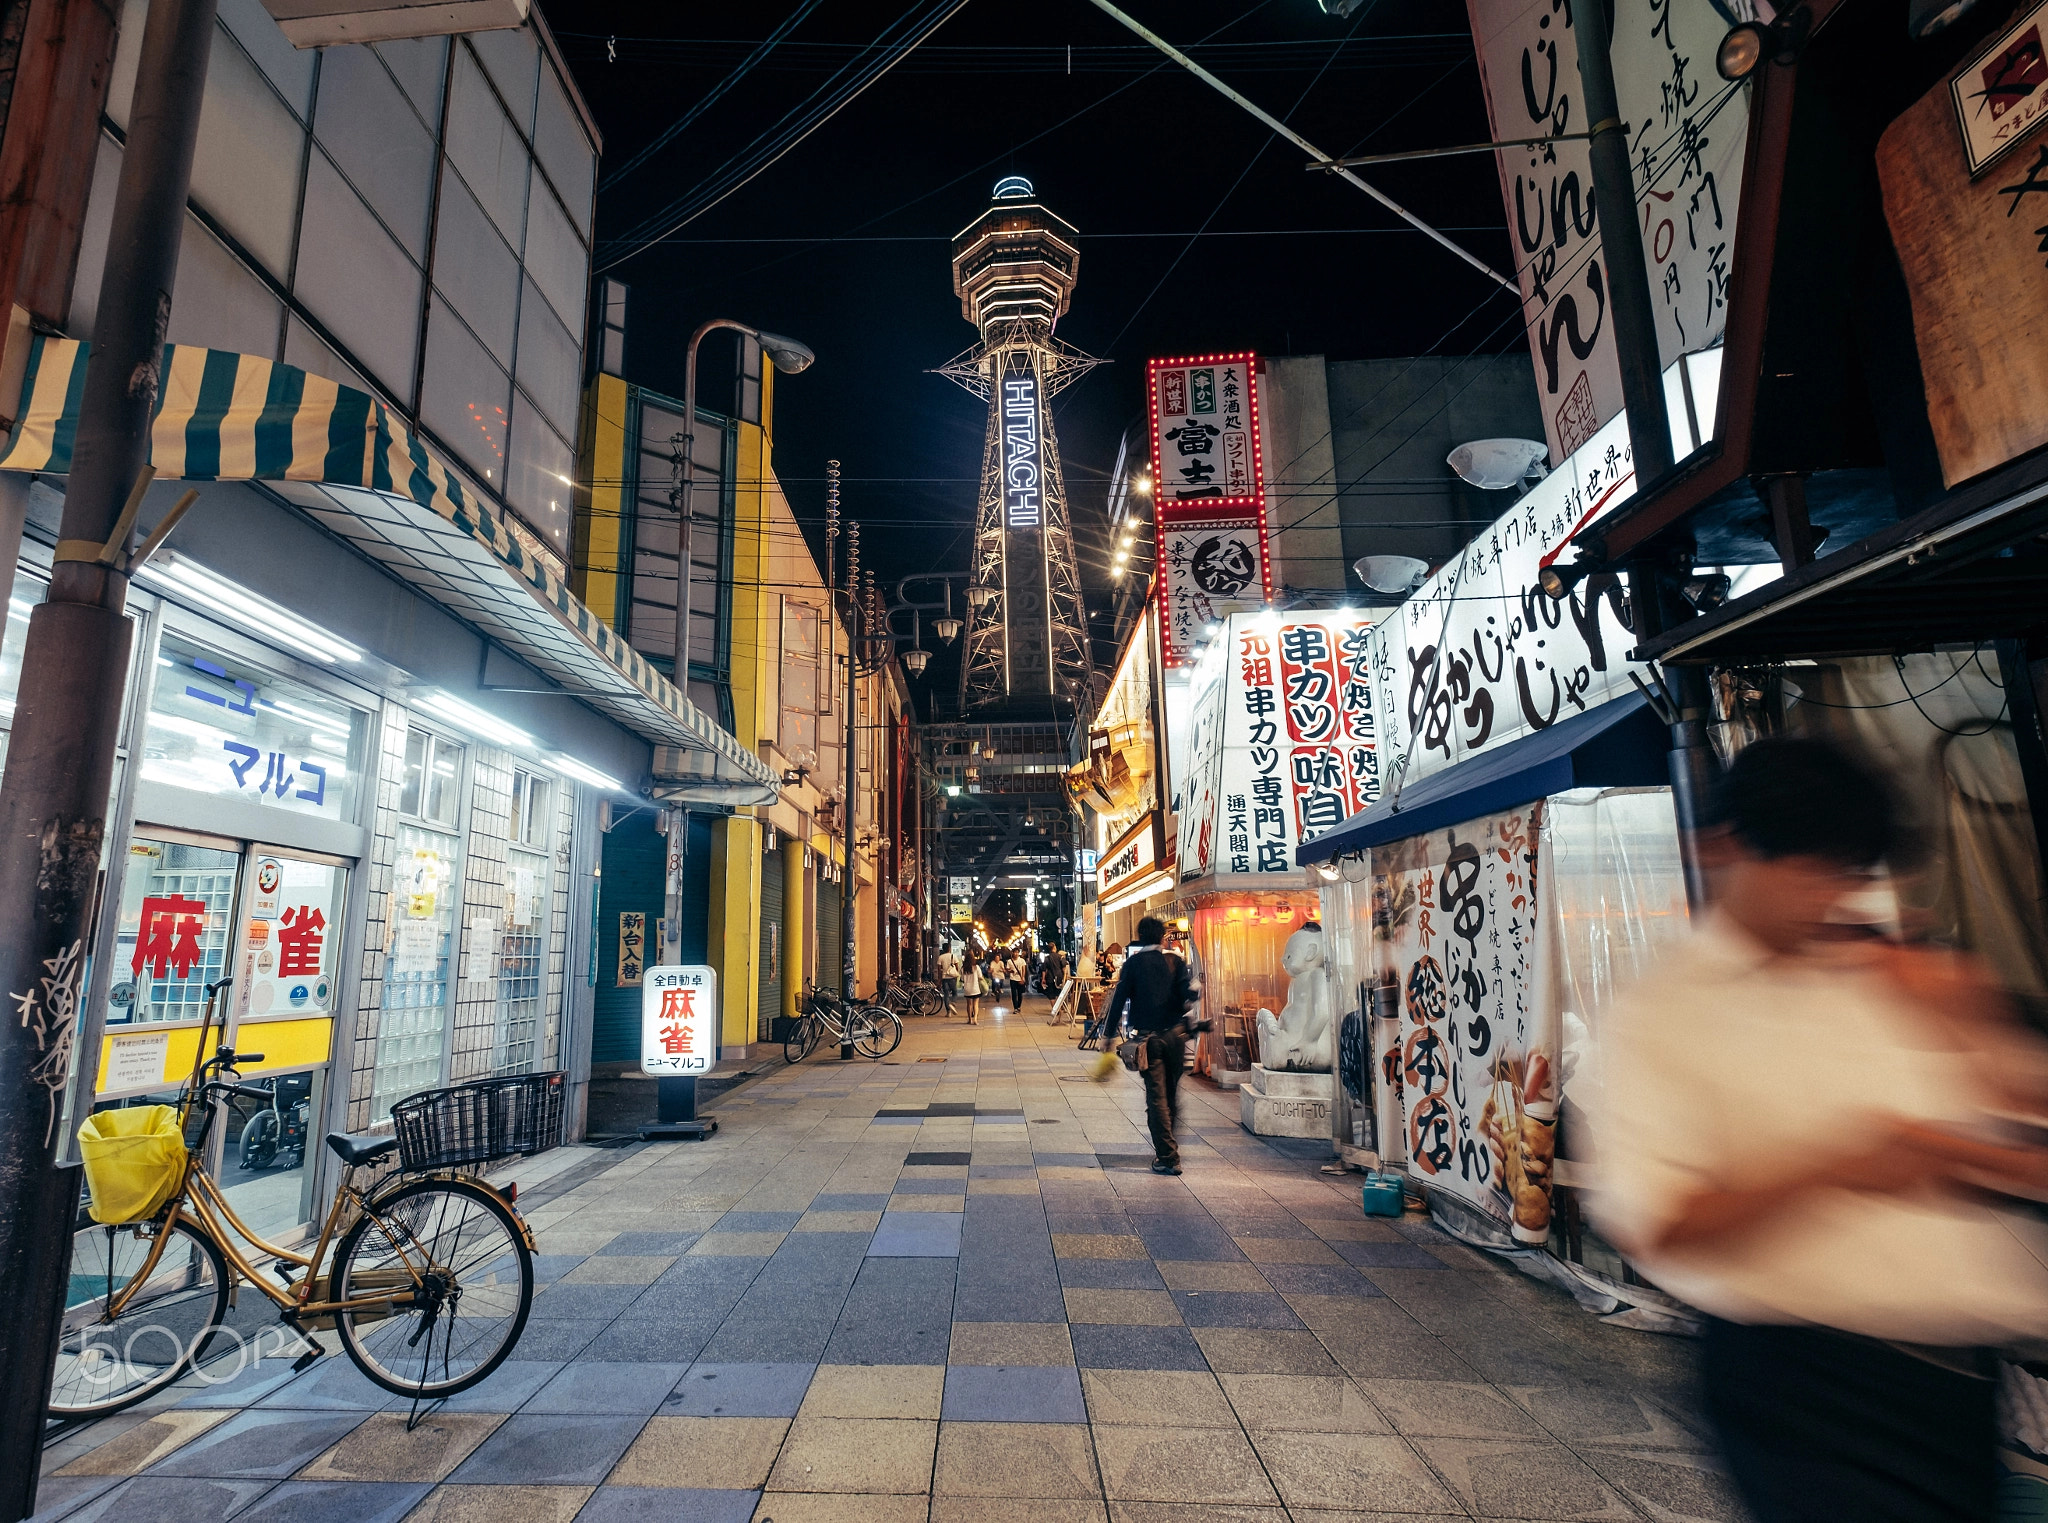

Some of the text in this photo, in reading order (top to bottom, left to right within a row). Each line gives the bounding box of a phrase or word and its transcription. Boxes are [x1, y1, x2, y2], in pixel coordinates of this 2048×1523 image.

[1164, 376, 1185, 413] 新世界
[1193, 372, 1214, 411] 串かつ
[1222, 367, 1242, 430] 大衆酒処
[1005, 380, 1040, 527] HITACHI
[1164, 418, 1224, 501] 富士
[1227, 444, 1248, 497] ソフト串かつ
[1283, 627, 1333, 742] 串カツ
[223, 739, 327, 806] マルコ
[1240, 628, 1289, 873] 元祖串カツ専門店
[1227, 793, 1250, 873] 通天閣店
[1294, 752, 1346, 844] 味自
[131, 893, 327, 979] 麻雀
[622, 914, 643, 980] 新台入替
[1439, 828, 1493, 1058] 串かつ
[653, 974, 704, 988] 全自動卓
[659, 987, 697, 1056] 麻雀
[647, 1056, 706, 1070] ニューマルコ
[1405, 957, 1456, 1175] 総本店
